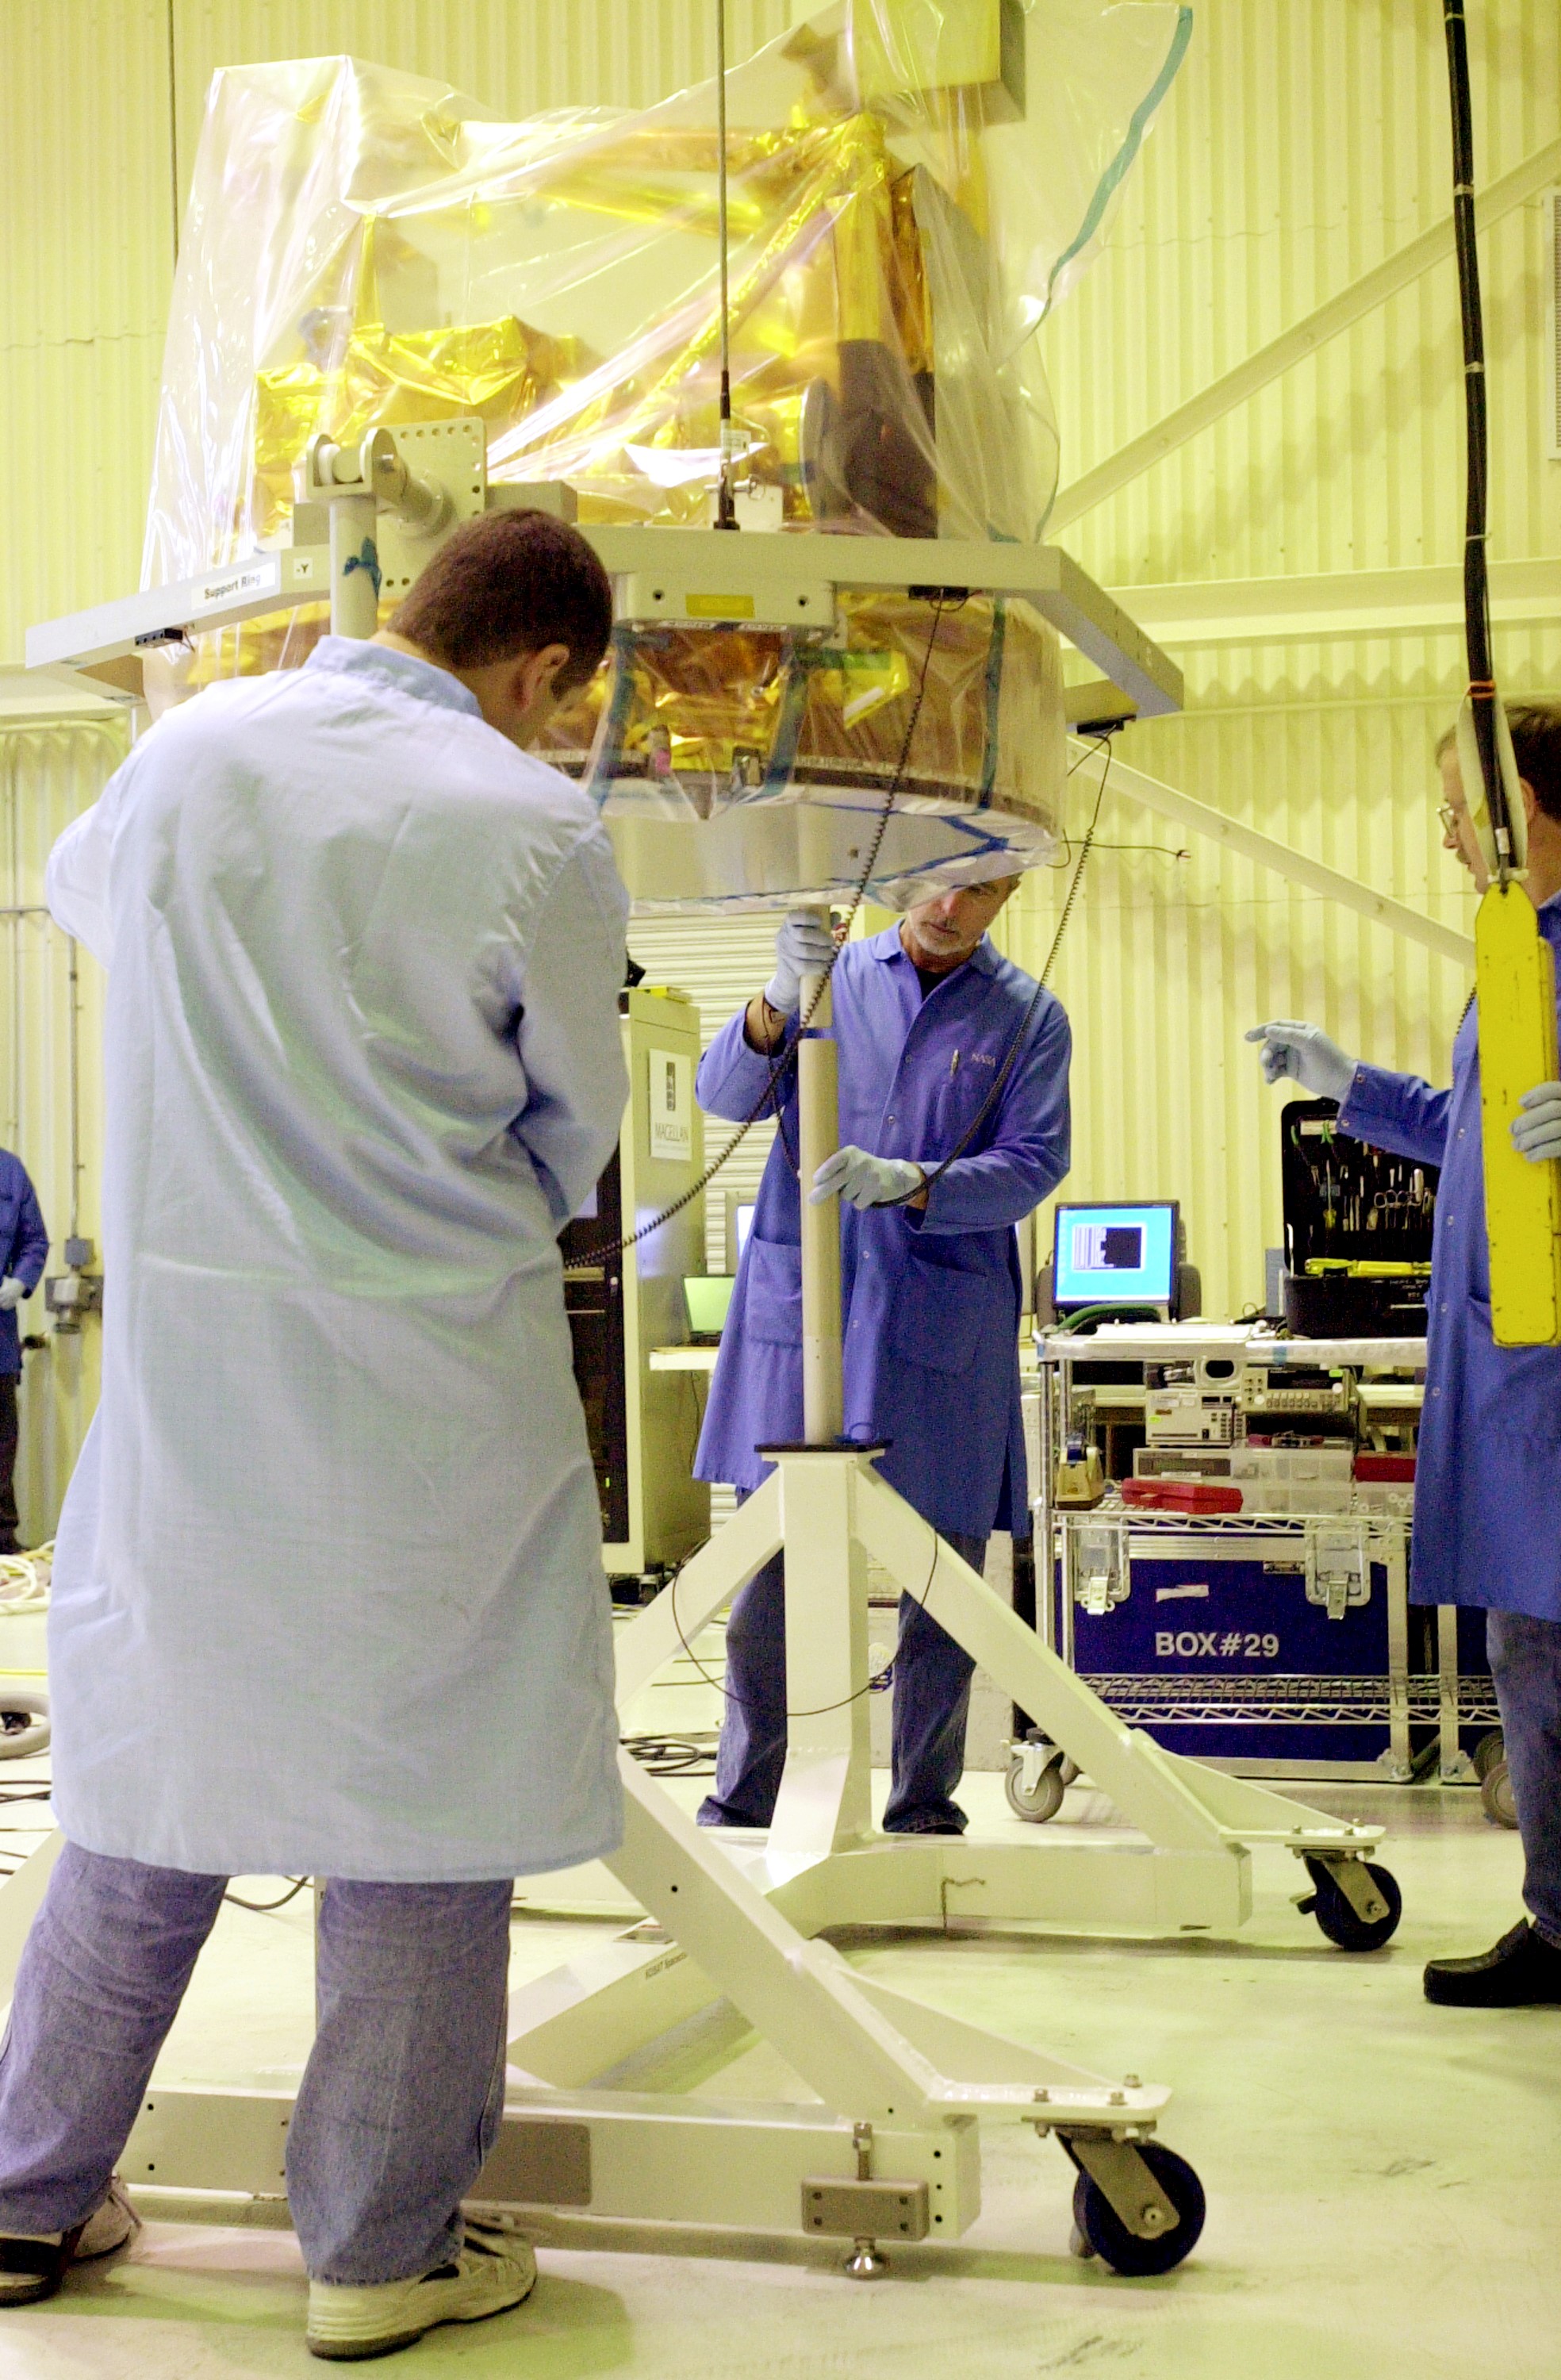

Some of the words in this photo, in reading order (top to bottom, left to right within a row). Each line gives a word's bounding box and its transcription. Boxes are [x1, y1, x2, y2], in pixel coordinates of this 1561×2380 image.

[204, 580, 239, 601] Support
[241, 574, 261, 588] Ring
[971, 1053, 995, 1068] NASA
[654, 1121, 688, 1142] MAGELLAN
